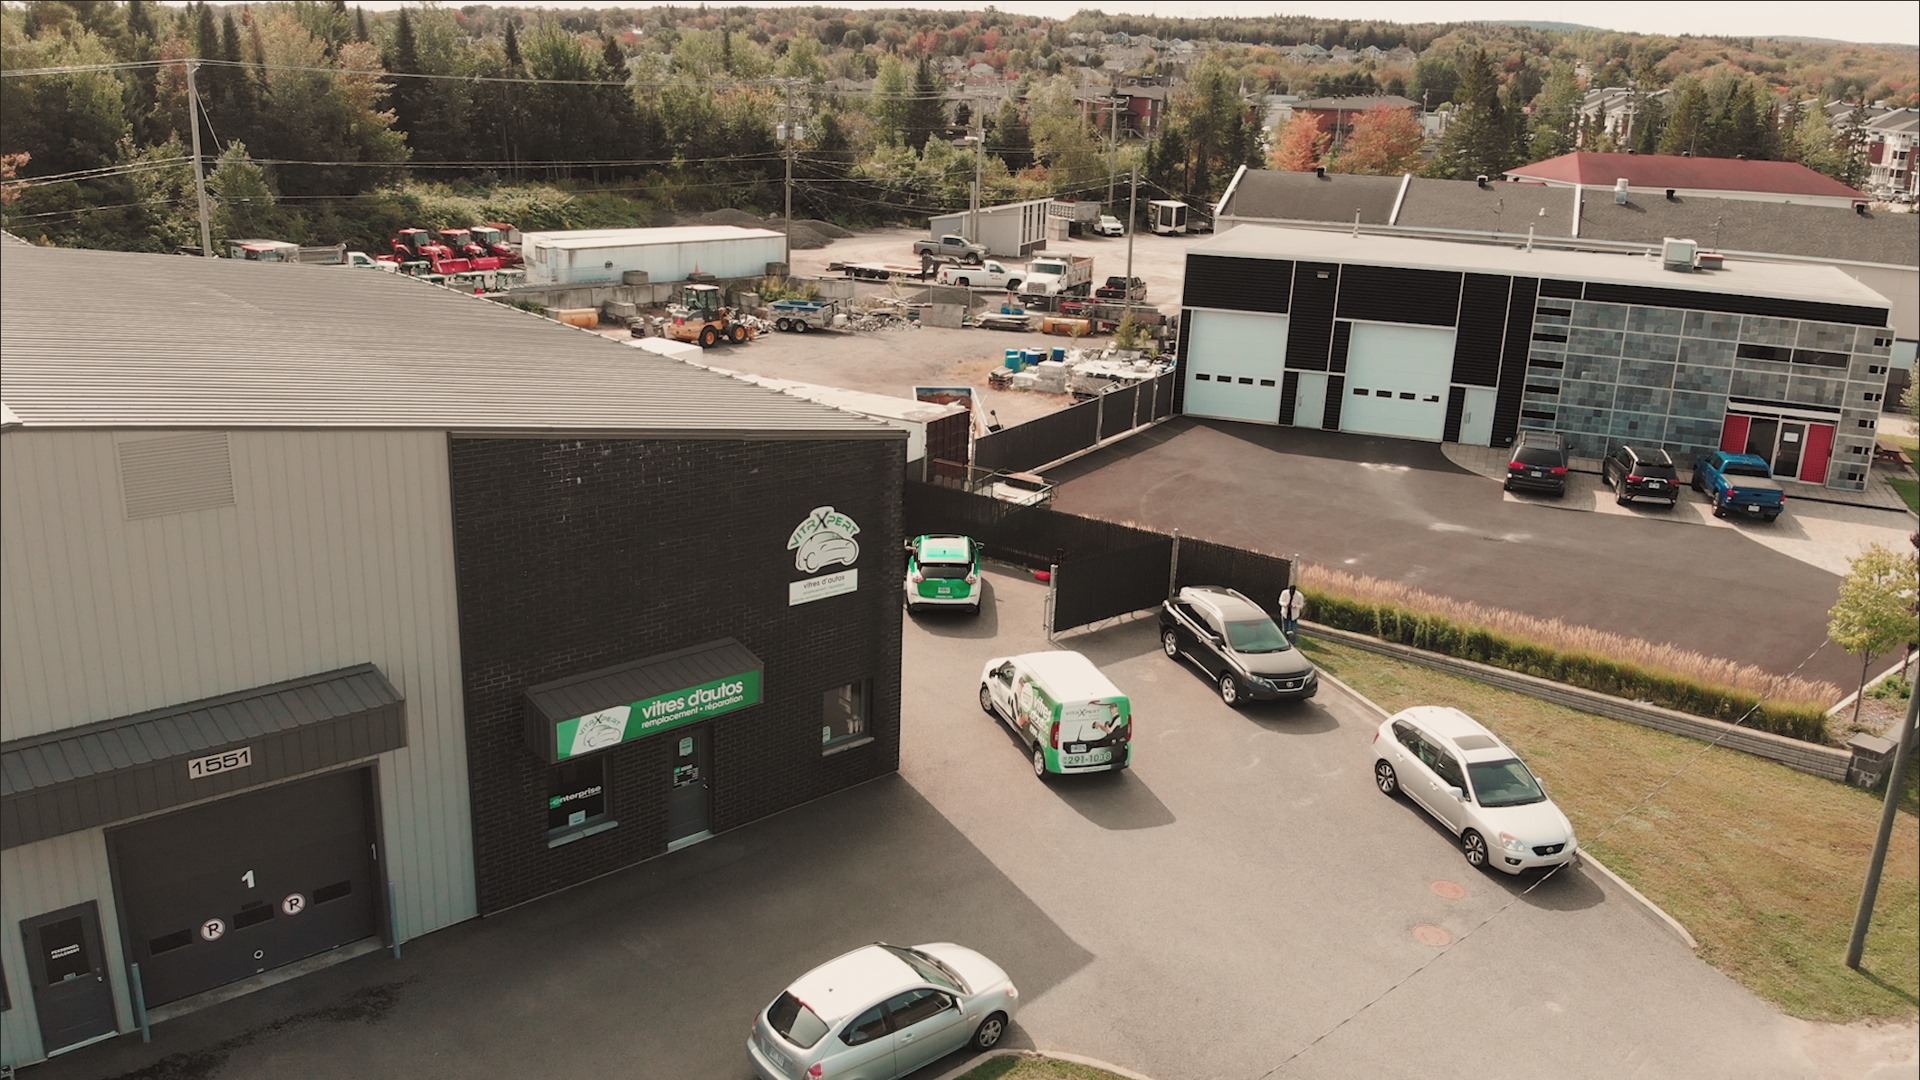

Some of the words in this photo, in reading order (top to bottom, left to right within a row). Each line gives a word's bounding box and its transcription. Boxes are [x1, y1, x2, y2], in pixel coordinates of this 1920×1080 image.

[803, 580, 820, 589] vitres
[642, 697, 685, 719] vitres
[687, 681, 744, 706] d'autos
[641, 706, 699, 729] remplacement
[704, 694, 744, 713] réparation
[192, 750, 248, 775] 1551
[1067, 751, 1112, 764] 291-1038
[549, 785, 602, 806] enterprise
[241, 869, 255, 889] 1
